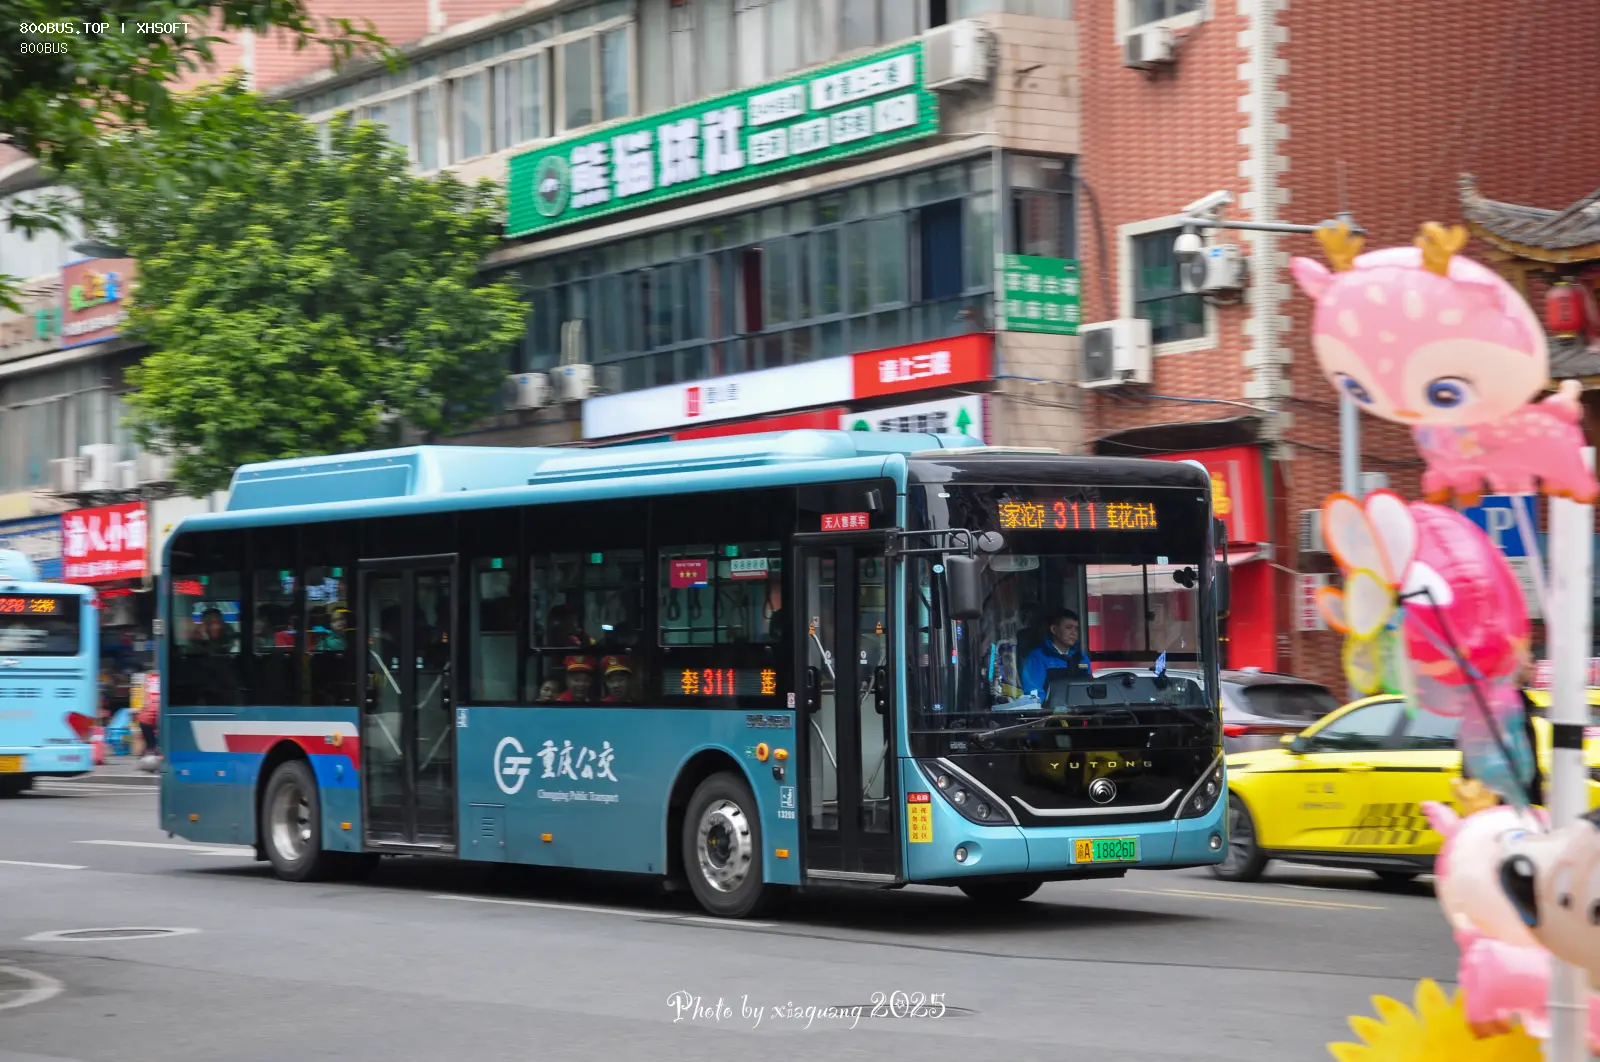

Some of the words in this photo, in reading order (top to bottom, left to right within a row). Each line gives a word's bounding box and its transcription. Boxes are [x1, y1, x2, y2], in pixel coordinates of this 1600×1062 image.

[824, 514, 867, 529] 无人售票车
[1052, 501, 1097, 530] 311
[1481, 506, 1516, 549] P
[703, 668, 735, 696] 311
[536, 739, 619, 782] 重庆公交
[1050, 760, 1153, 769] YUTONG
